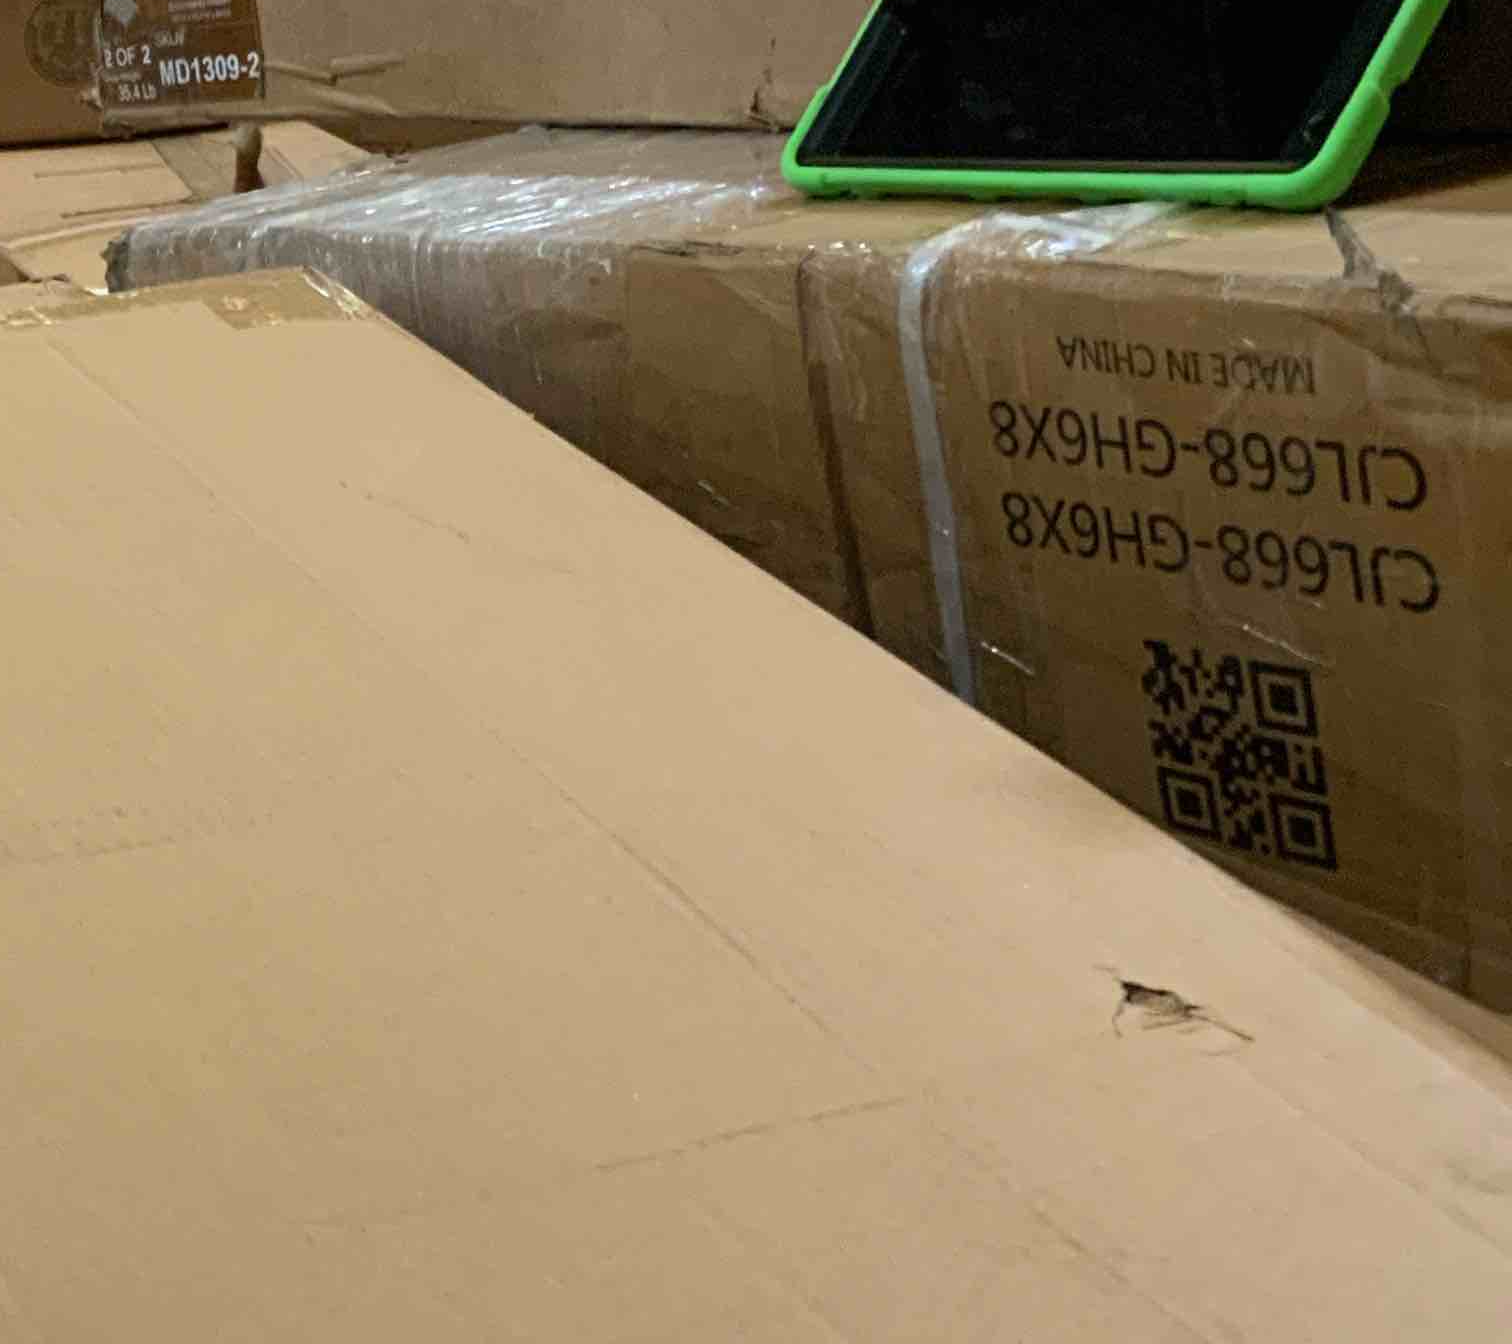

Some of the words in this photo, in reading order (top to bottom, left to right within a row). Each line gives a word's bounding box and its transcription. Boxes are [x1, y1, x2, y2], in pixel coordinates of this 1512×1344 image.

[104, 49, 113, 68] 2
[116, 47, 137, 66] OF
[141, 45, 153, 65] 2
[159, 51, 261, 86] MD1309-2
[1056, 335, 1156, 378] CHINA
[1165, 348, 1203, 384] IN
[1209, 353, 1316, 394] MADE
[988, 399, 1428, 514] CJL668-GH6X8
[1002, 491, 1442, 616] CJL668-GH6X8
